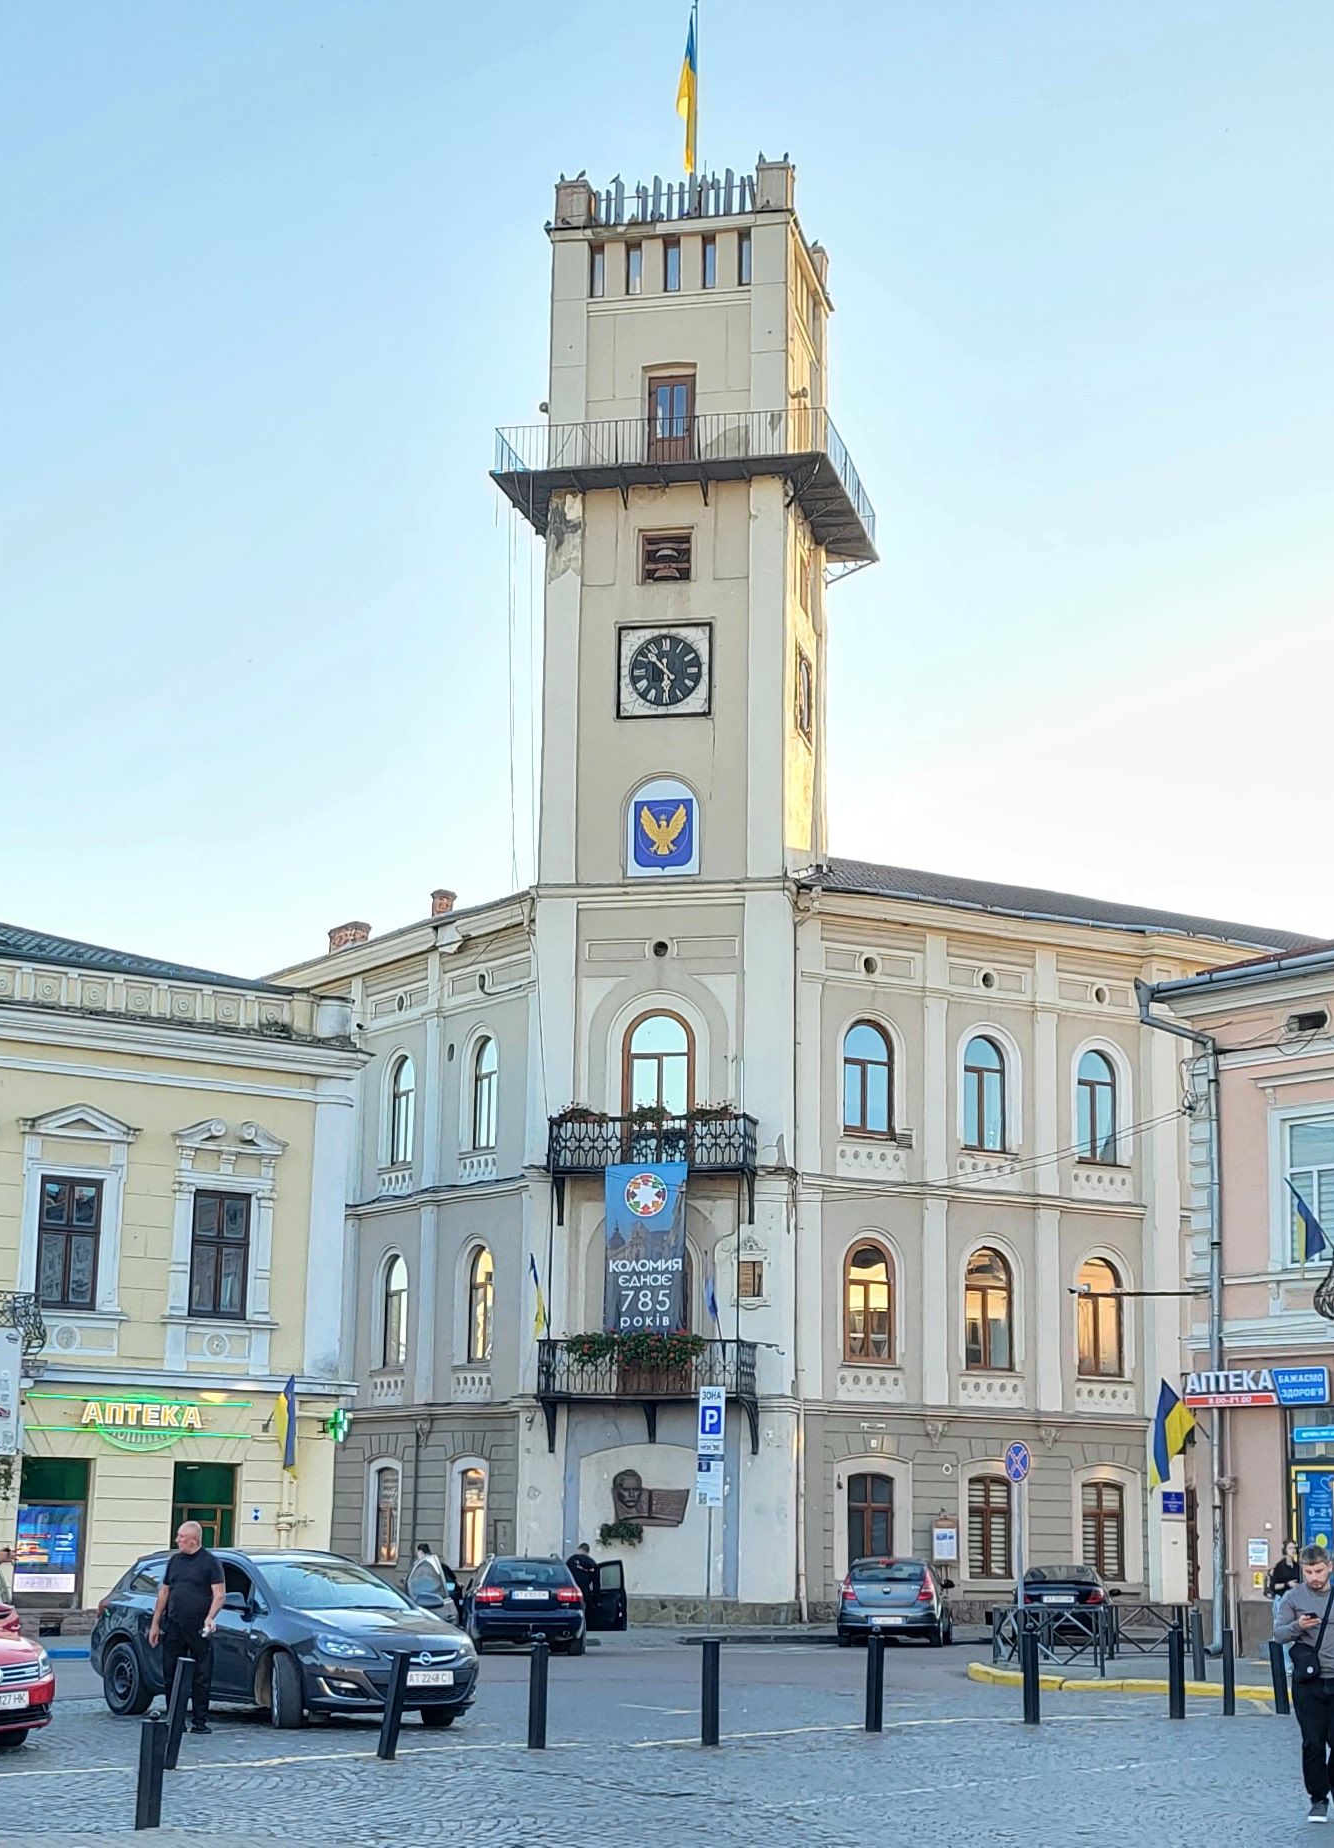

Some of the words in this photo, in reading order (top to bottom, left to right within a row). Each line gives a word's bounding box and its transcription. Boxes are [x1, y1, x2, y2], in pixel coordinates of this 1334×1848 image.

[609, 1258, 682, 1272] КОЛОМИЯ
[620, 1290, 670, 1312] 785
[620, 1313, 669, 1329] років
[1185, 1369, 1275, 1393] АПТЕКА
[702, 1391, 721, 1400] ЗОНА
[81, 1401, 202, 1429] АПТЕКА
[1308, 1508, 1333, 1517] 8-21
[409, 1673, 420, 1683] AT
